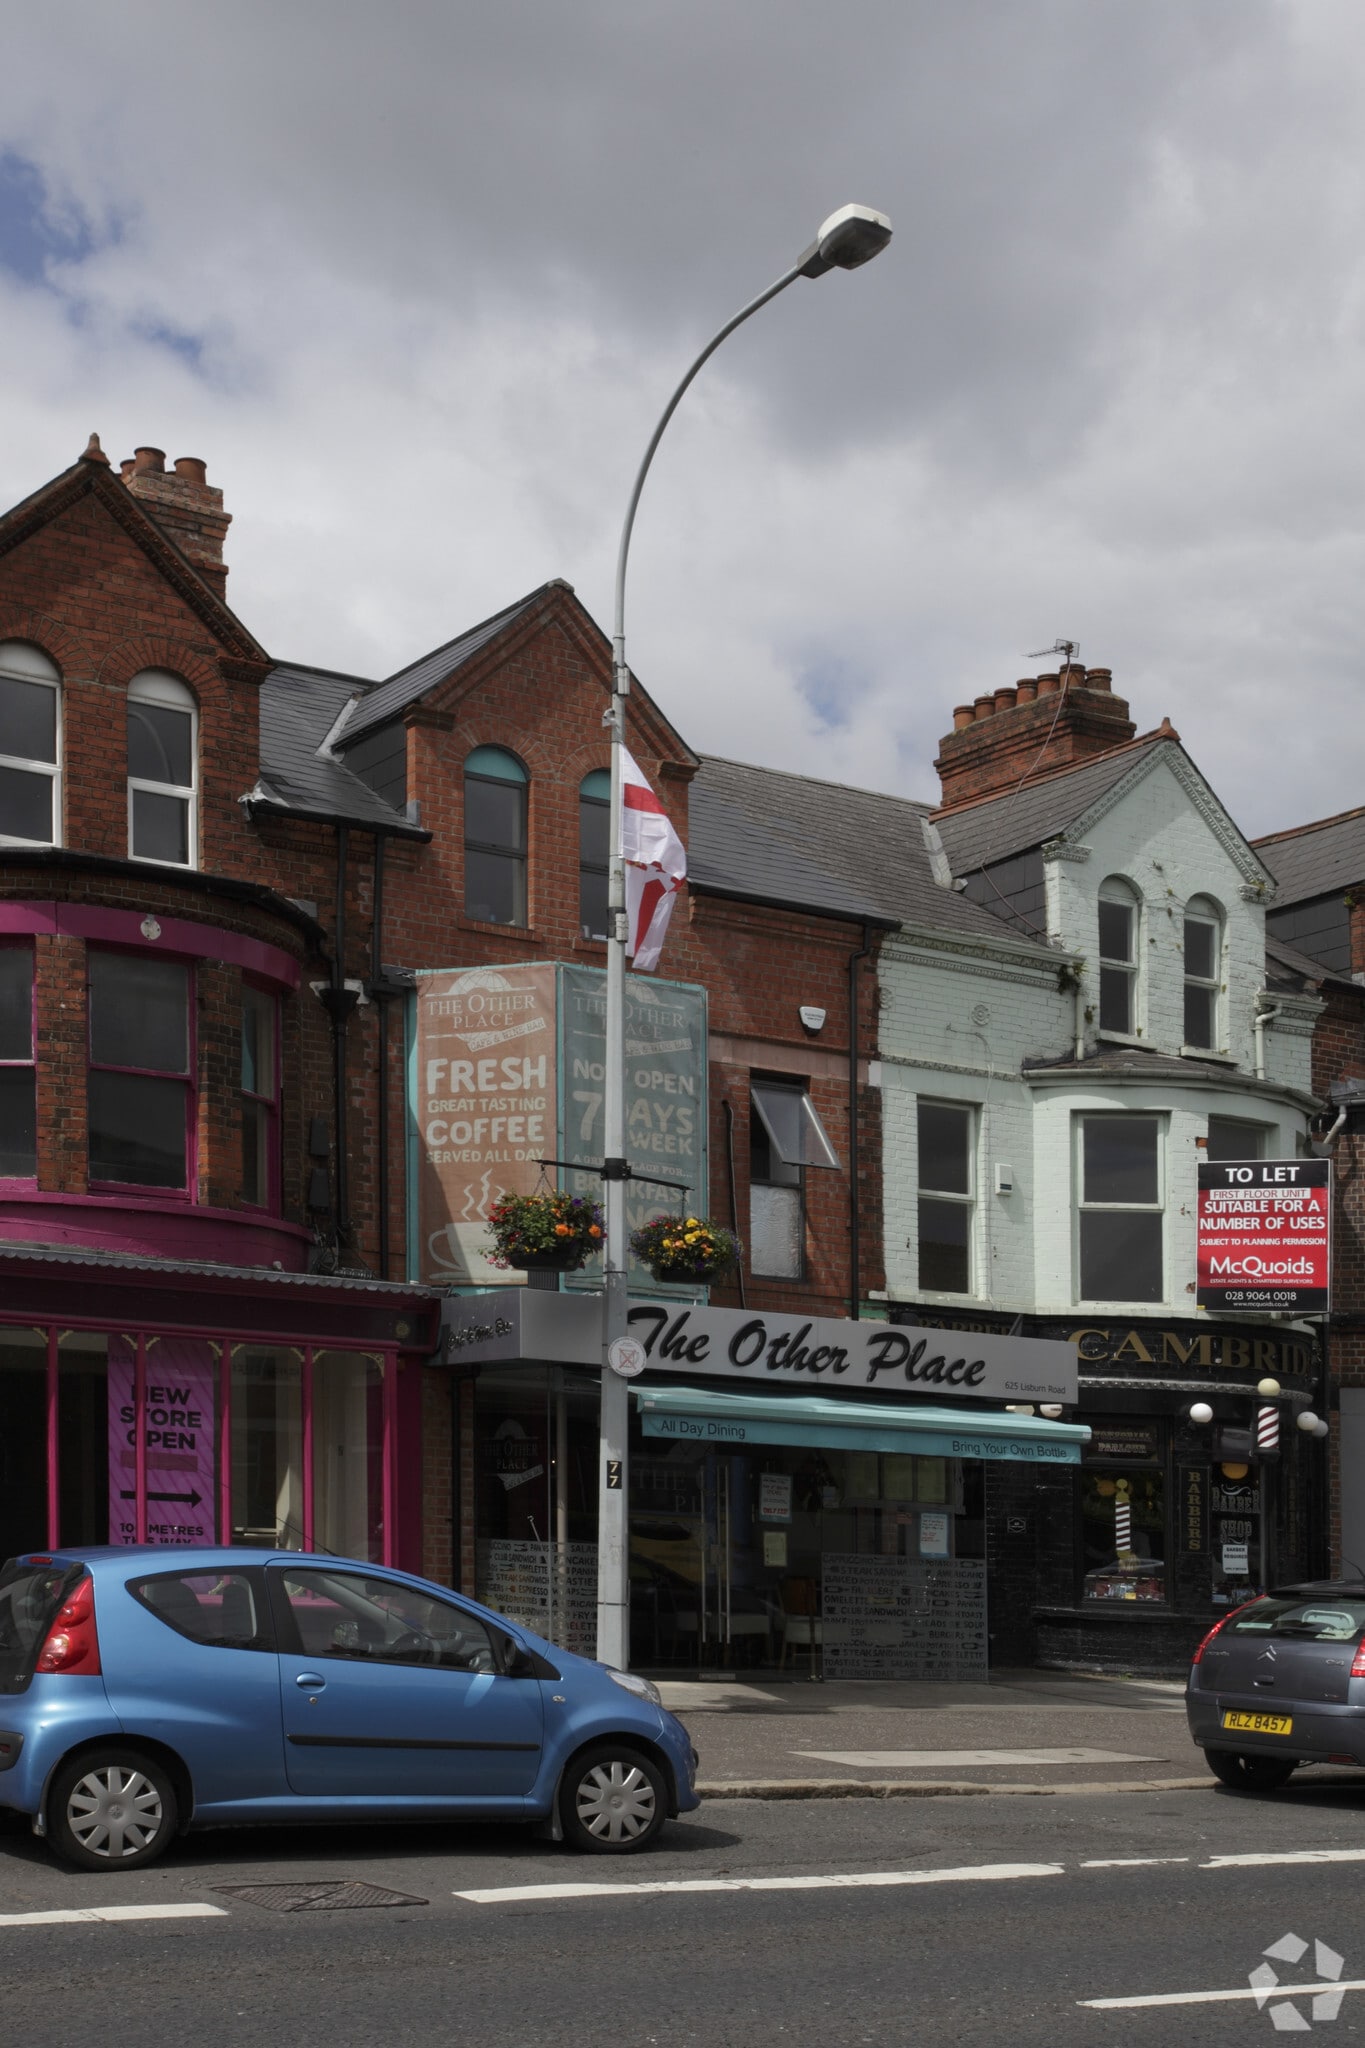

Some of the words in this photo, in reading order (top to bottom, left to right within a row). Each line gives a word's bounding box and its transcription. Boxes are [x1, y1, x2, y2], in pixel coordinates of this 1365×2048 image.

[425, 1000, 464, 1016] THE
[468, 994, 537, 1013] OTHER
[453, 1013, 515, 1029] PLACE
[426, 1055, 546, 1094] FRESH
[635, 1070, 694, 1096] OPEN
[427, 1098, 476, 1113] GREAT
[480, 1097, 546, 1112] TASTING
[572, 1090, 602, 1140] 7
[625, 1098, 693, 1135] AYS
[426, 1116, 544, 1145] COFFEE
[629, 1129, 692, 1156] WEEK
[426, 1150, 481, 1164] SERVED
[484, 1149, 511, 1162] ALL
[515, 1148, 544, 1161] DAY
[1225, 1167, 1253, 1183] TO
[1262, 1166, 1300, 1182] LET
[1213, 1190, 1240, 1199] FIRST
[1244, 1189, 1277, 1198] FLOOR
[1282, 1189, 1306, 1198] UNIT
[1205, 1200, 1268, 1213] SUITABLE
[1274, 1200, 1303, 1212] FOR
[1308, 1200, 1320, 1212] A
[1200, 1217, 1260, 1230] NUMBER
[1265, 1217, 1284, 1229] OF
[1290, 1216, 1325, 1229] USES
[1200, 1238, 1228, 1246] SUBJECT
[1209, 1256, 1314, 1277] McQuoids
[1225, 1292, 1243, 1300] 028
[1246, 1292, 1270, 1300] 9064
[1273, 1292, 1297, 1300] 0018
[627, 1306, 711, 1363] The
[728, 1319, 850, 1374] Other
[867, 1331, 986, 1386] Place
[1005, 1381, 1018, 1392] 625
[1020, 1382, 1046, 1393] Lisburn
[1048, 1383, 1066, 1394] Road
[660, 1420, 676, 1433] All
[680, 1422, 705, 1437] Day
[707, 1423, 746, 1440] Dining
[952, 1441, 980, 1457] Bring
[982, 1442, 1007, 1455] Your
[1010, 1444, 1034, 1456] Own
[1036, 1444, 1067, 1457] Bottle
[1212, 1486, 1260, 1513] BARBER
[1188, 1471, 1201, 1550] BARBERS
[149, 1524, 204, 1537] METRES
[1220, 1520, 1252, 1544] SHOP
[841, 1567, 873, 1575] STEAK
[824, 1576, 858, 1585] BAKED
[841, 1606, 862, 1614] CLUB
[864, 1607, 907, 1617] SANDWICH
[1229, 1713, 1251, 1727] RLZ
[1254, 1715, 1287, 1731] 8457
